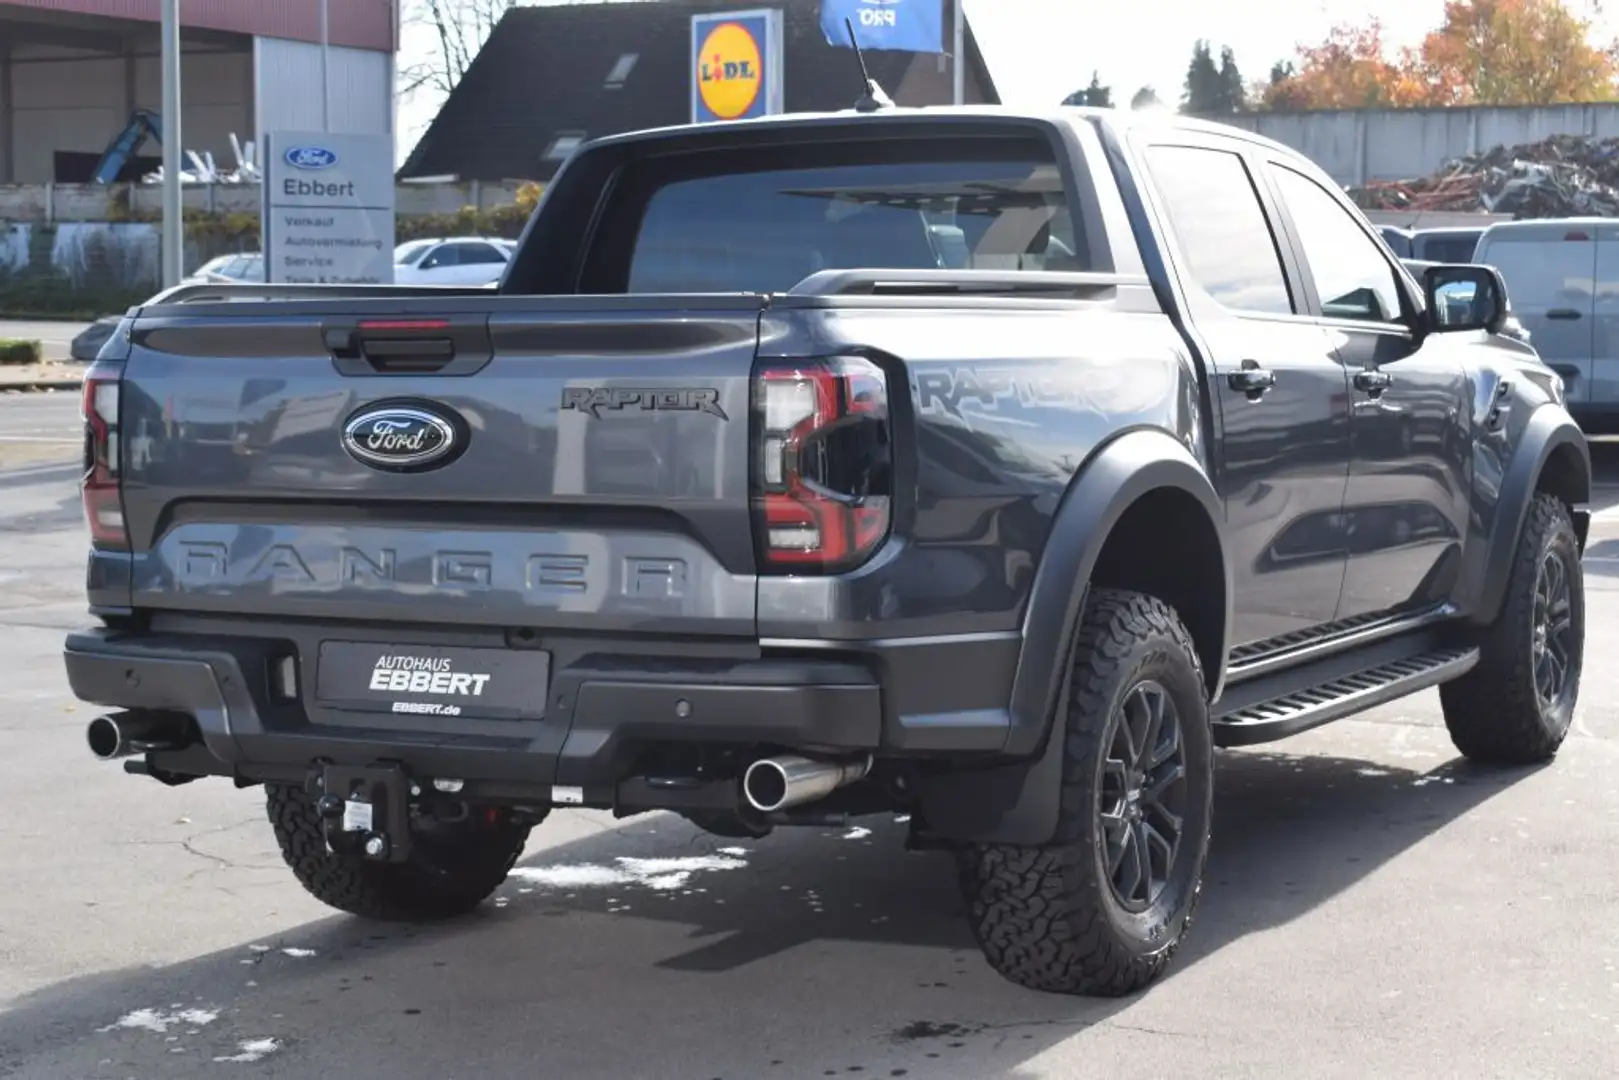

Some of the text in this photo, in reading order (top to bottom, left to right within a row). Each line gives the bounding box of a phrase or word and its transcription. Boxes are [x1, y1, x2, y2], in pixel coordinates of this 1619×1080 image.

[284, 179, 354, 196] Ebbert
[284, 217, 334, 226] Verkauf
[284, 256, 333, 266] Service
[561, 387, 729, 421] RAPTOR
[367, 420, 425, 450] Ford
[178, 540, 689, 598] RANGER
[376, 656, 451, 672] AUTOHAUS
[369, 669, 490, 696] EBBERT
[392, 702, 461, 716] EBBERT.de
